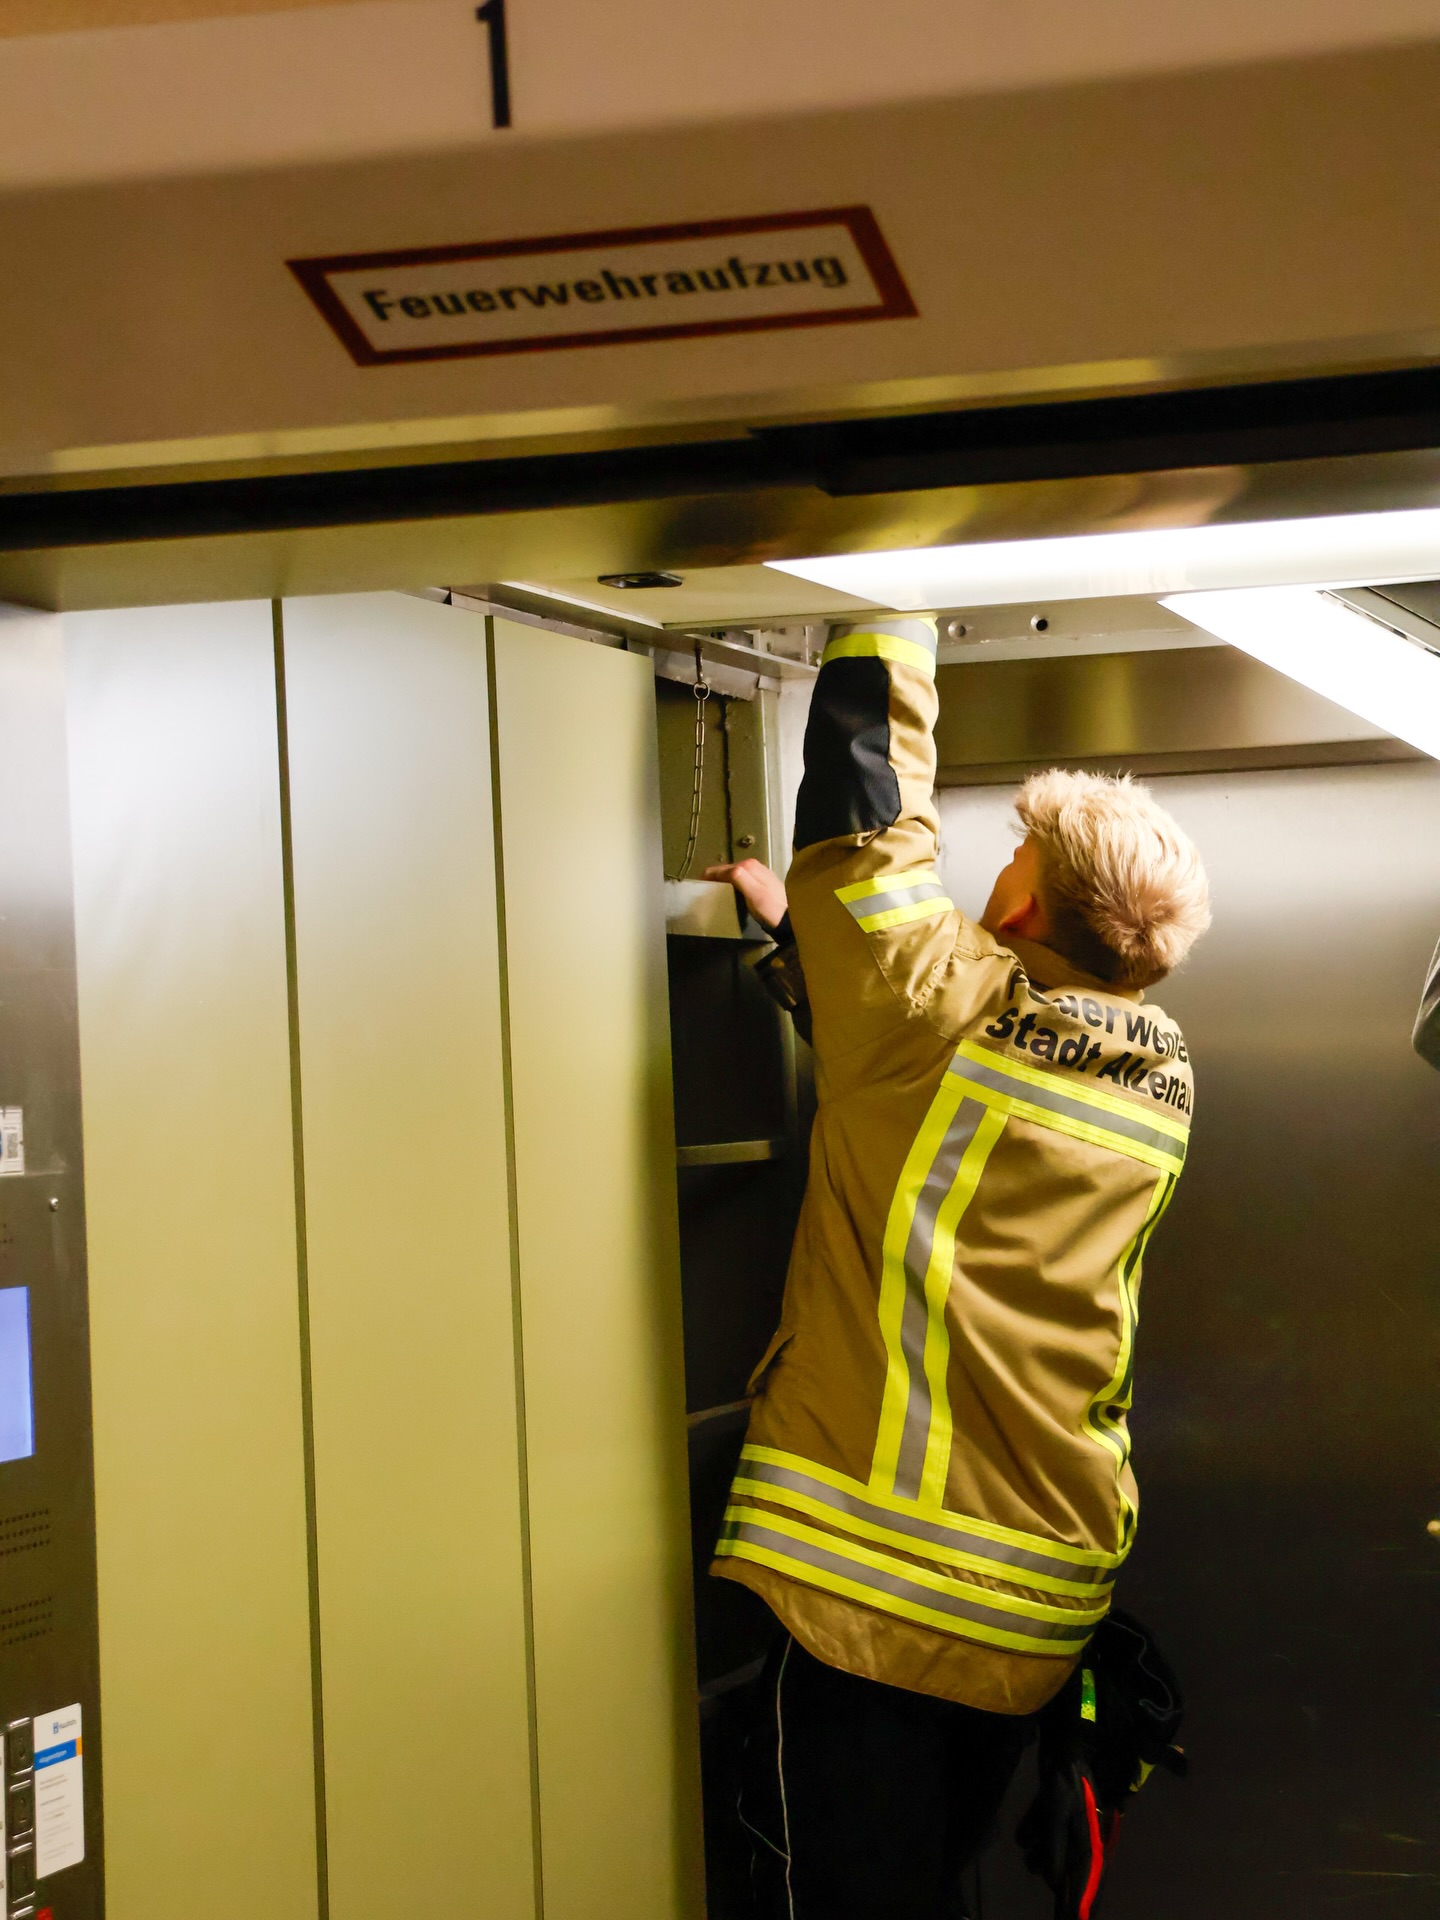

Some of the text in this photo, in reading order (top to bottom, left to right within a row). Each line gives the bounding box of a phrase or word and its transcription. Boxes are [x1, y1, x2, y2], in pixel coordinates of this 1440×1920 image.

[475, 0, 511, 129] 1
[361, 256, 847, 321] Feuerwehraufzug
[985, 1006, 1101, 1073] Stadt
